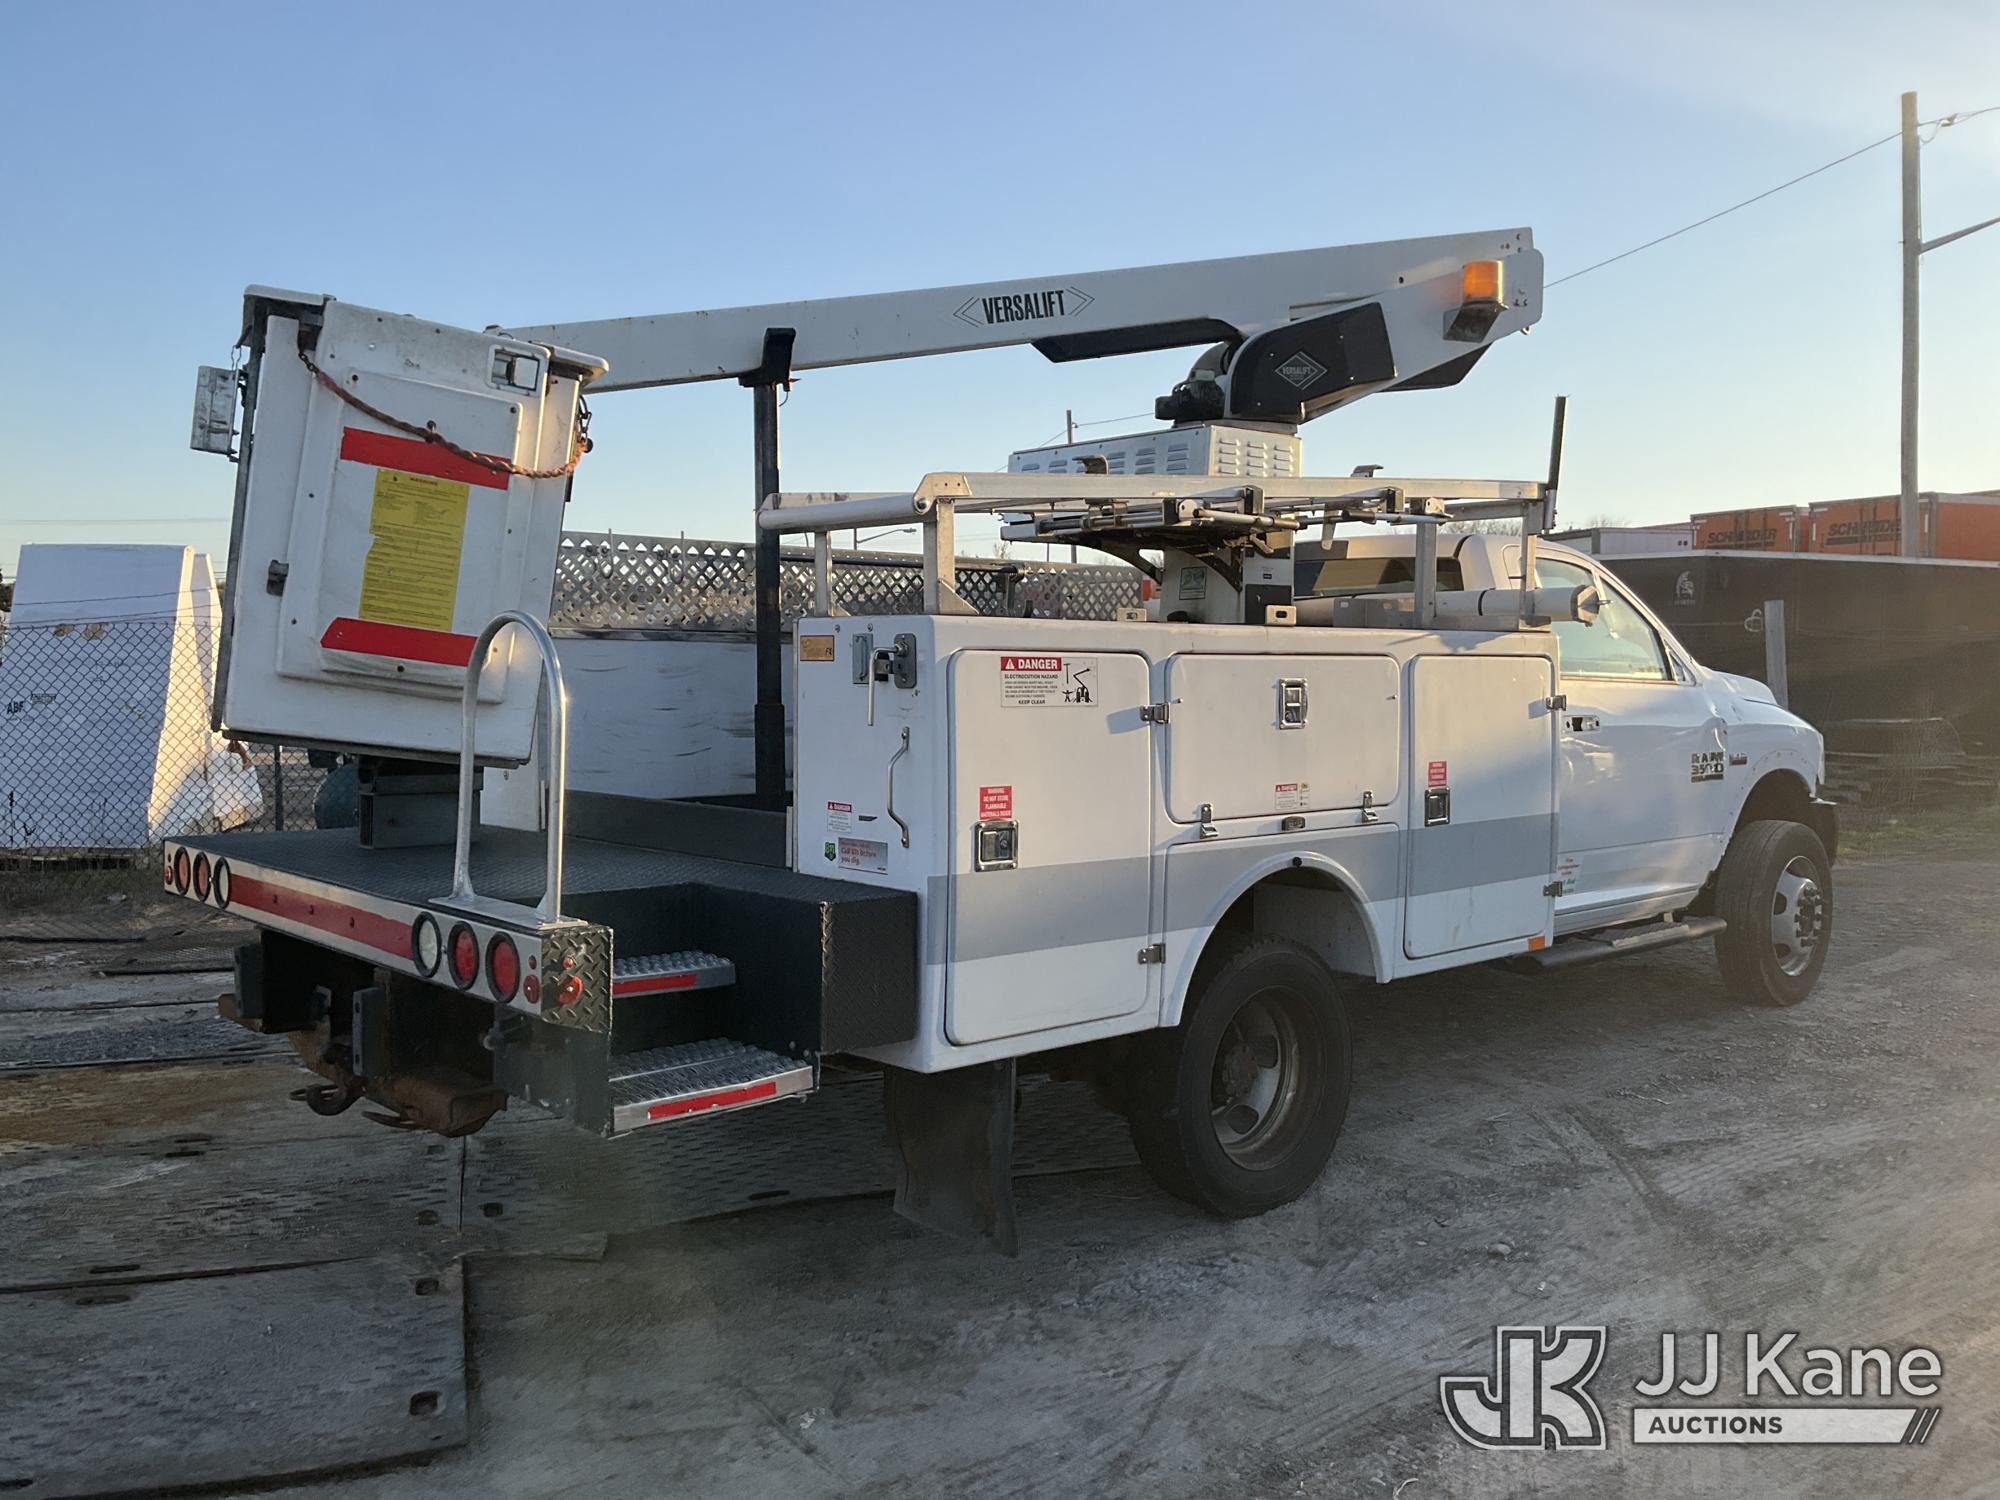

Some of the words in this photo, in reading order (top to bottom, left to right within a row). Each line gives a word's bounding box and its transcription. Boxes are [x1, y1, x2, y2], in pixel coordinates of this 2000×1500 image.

[982, 289, 1065, 324] VERSALIFT
[1017, 658, 1059, 670] DANGER
[1691, 751, 1724, 764] RAM
